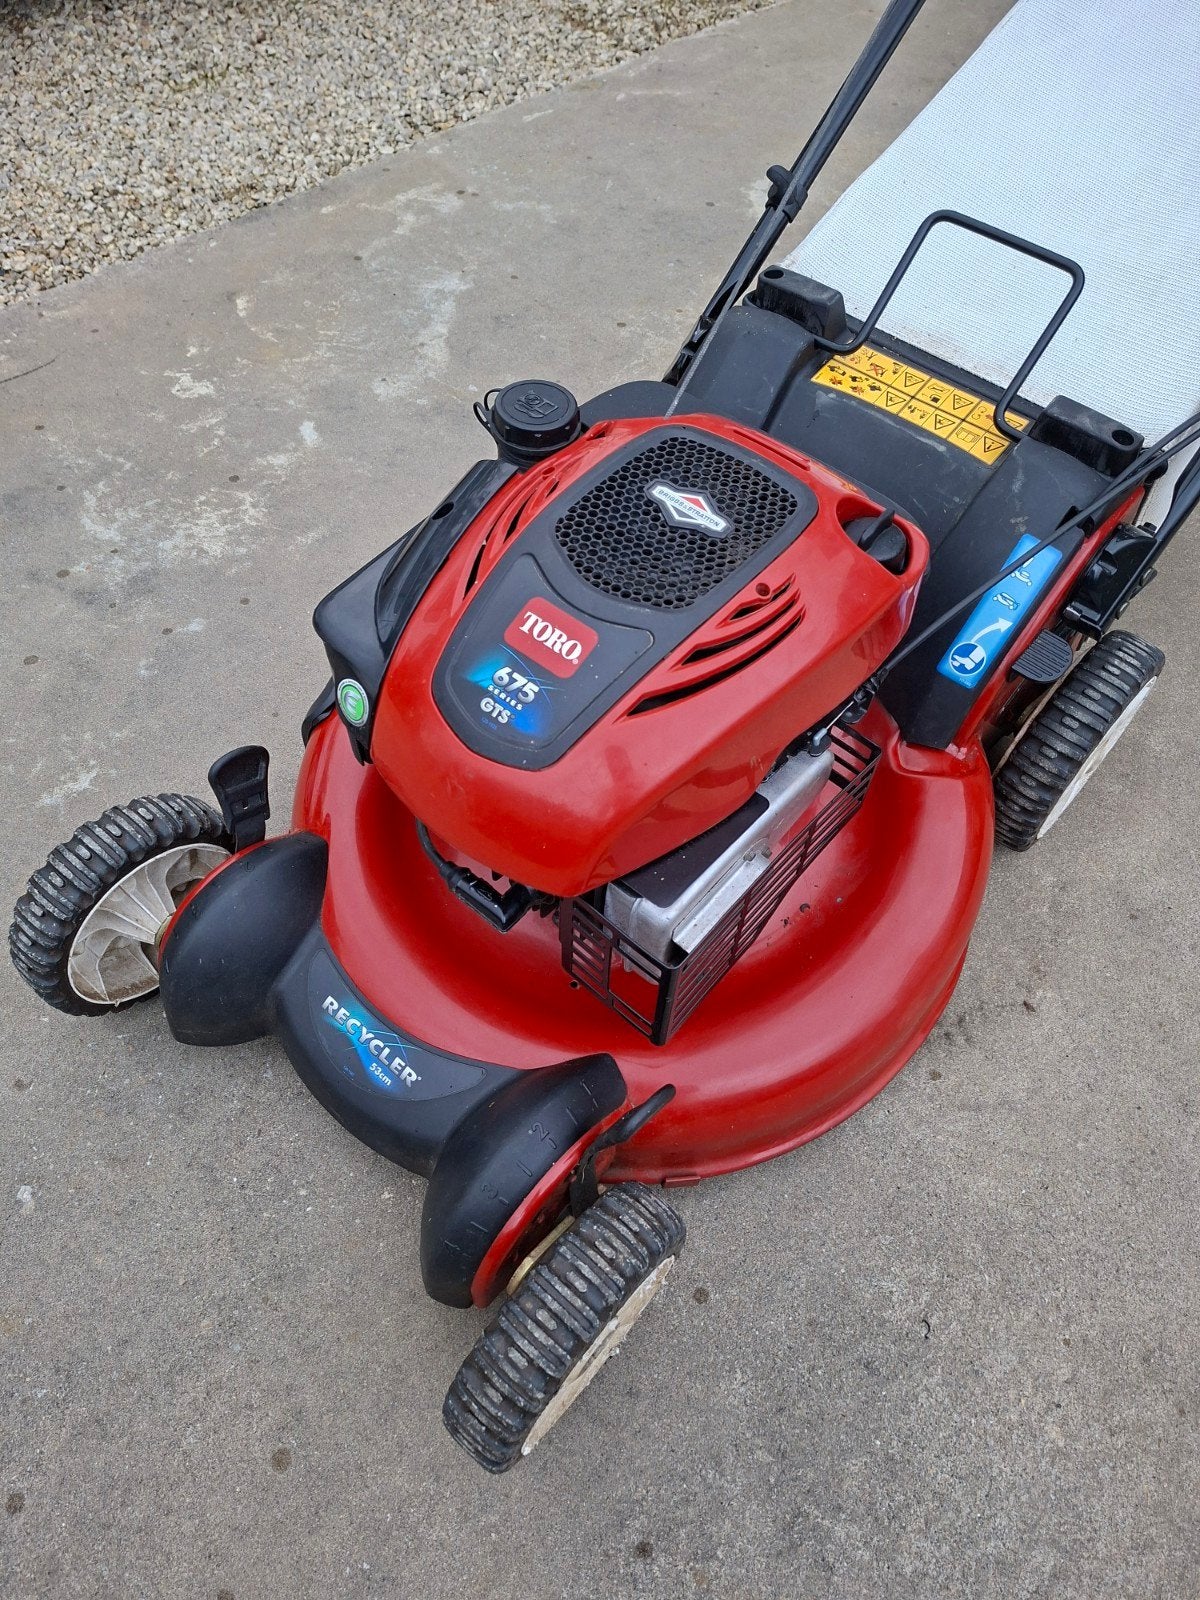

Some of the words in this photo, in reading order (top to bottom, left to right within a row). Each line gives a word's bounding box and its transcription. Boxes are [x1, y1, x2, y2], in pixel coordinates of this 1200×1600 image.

[518, 611, 583, 661] TORO
[487, 684, 523, 711] SERIES
[492, 666, 540, 704] 675
[479, 697, 512, 724] GTS
[322, 995, 418, 1088] RECYCLER
[369, 1062, 392, 1086] 53cm
[531, 1121, 549, 1142] 2
